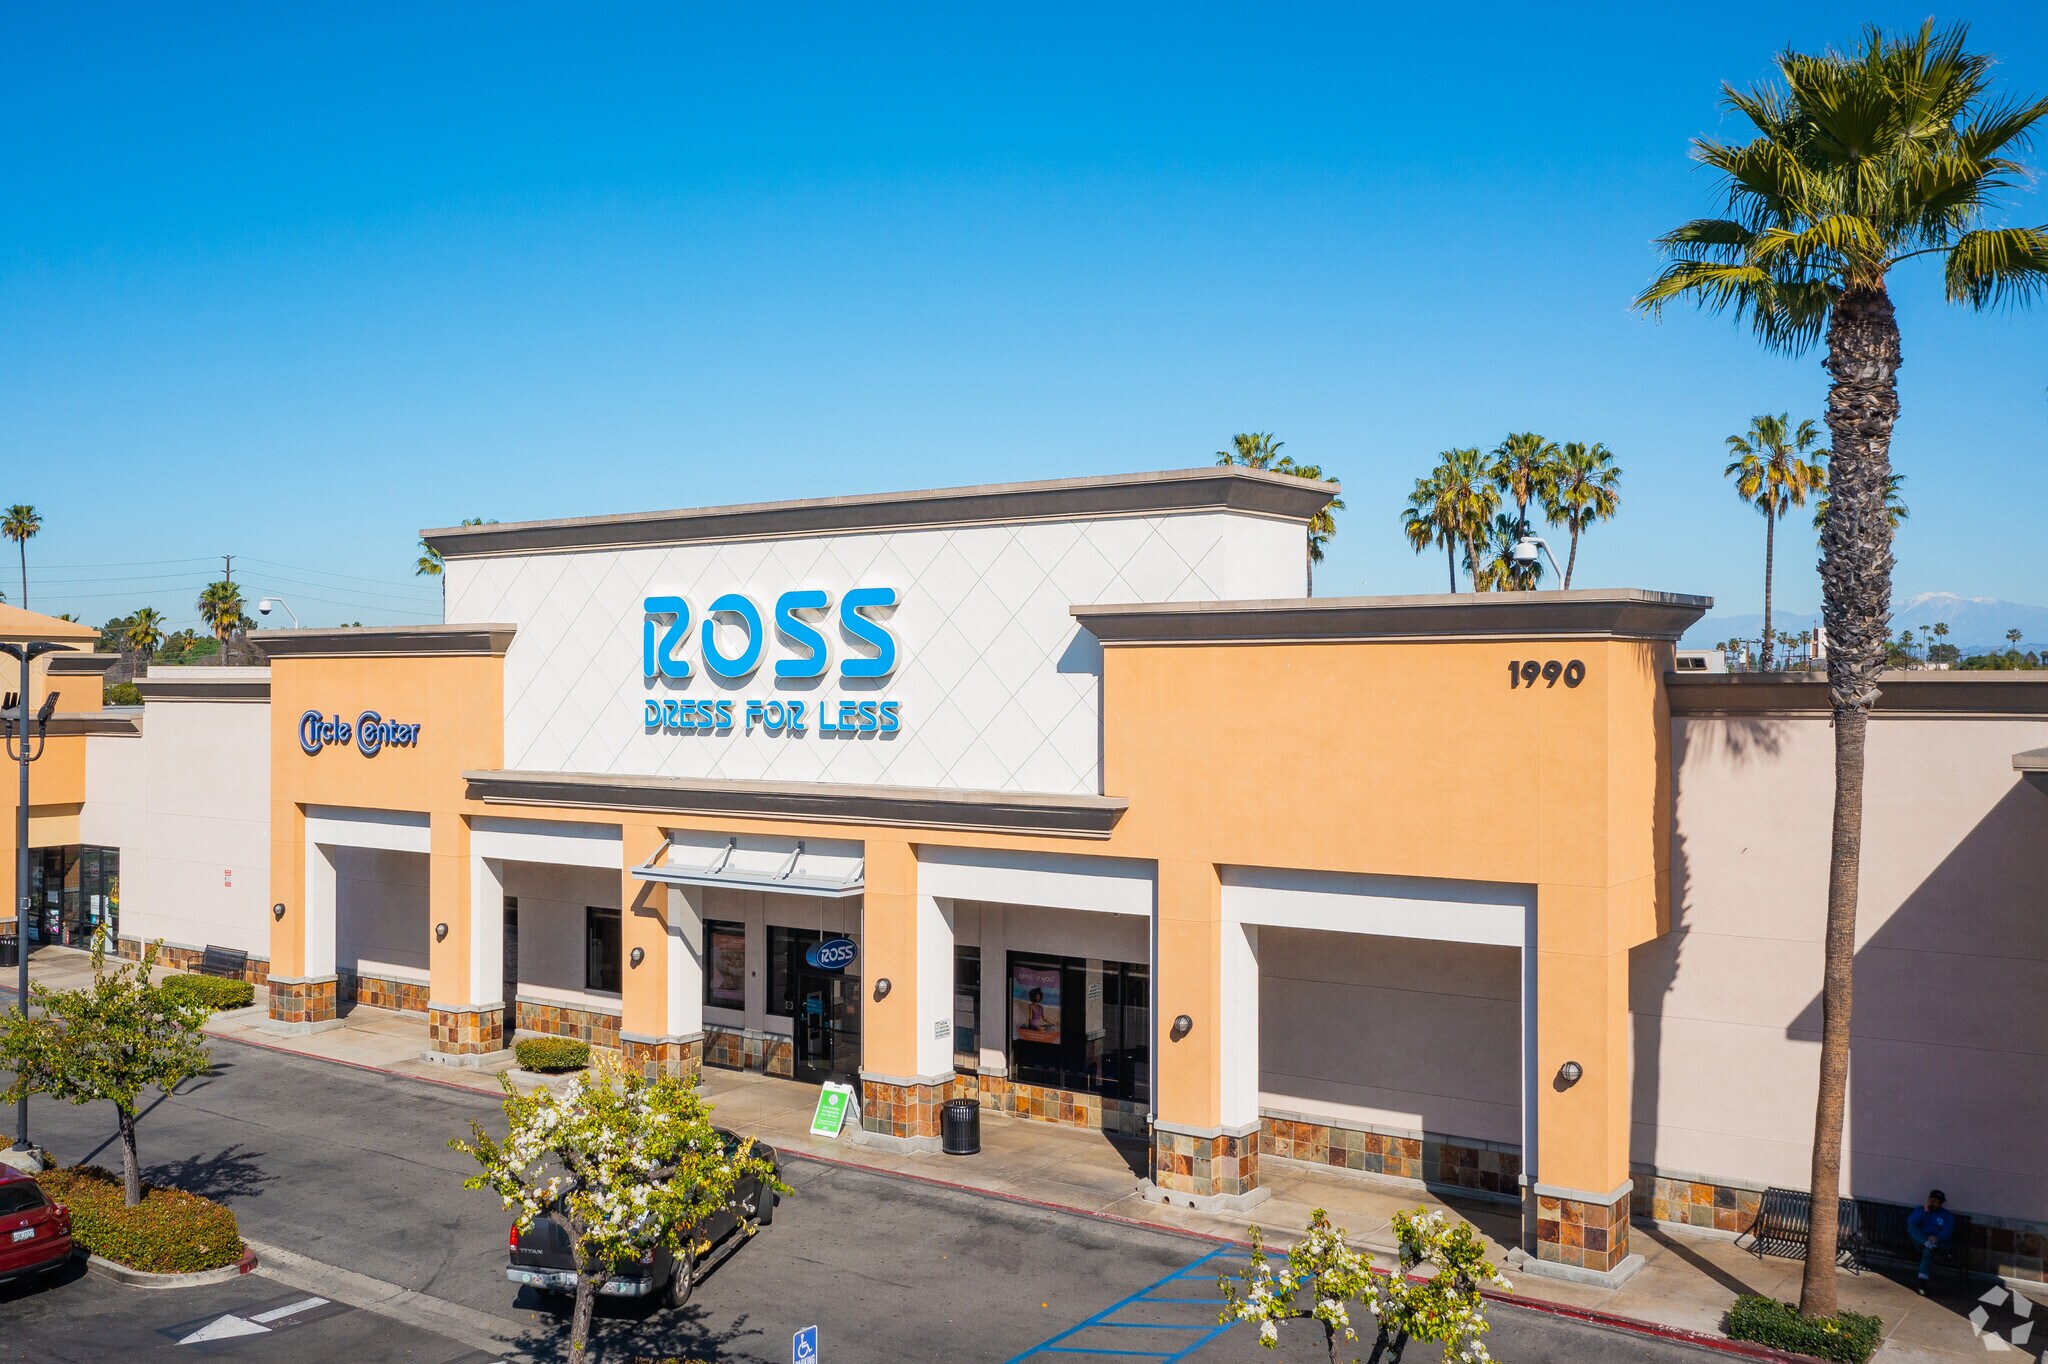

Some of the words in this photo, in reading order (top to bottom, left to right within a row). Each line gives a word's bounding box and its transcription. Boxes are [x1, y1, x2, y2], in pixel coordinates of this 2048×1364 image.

[644, 587, 901, 678] ROSS
[1508, 659, 1586, 689] 1990
[645, 699, 735, 728] DRESS
[745, 700, 807, 730] FOR
[819, 701, 902, 732] LESS
[299, 710, 352, 754] Circle
[355, 711, 420, 757] Center
[821, 945, 853, 963] ROSS
[519, 1247, 543, 1255] TITAN
